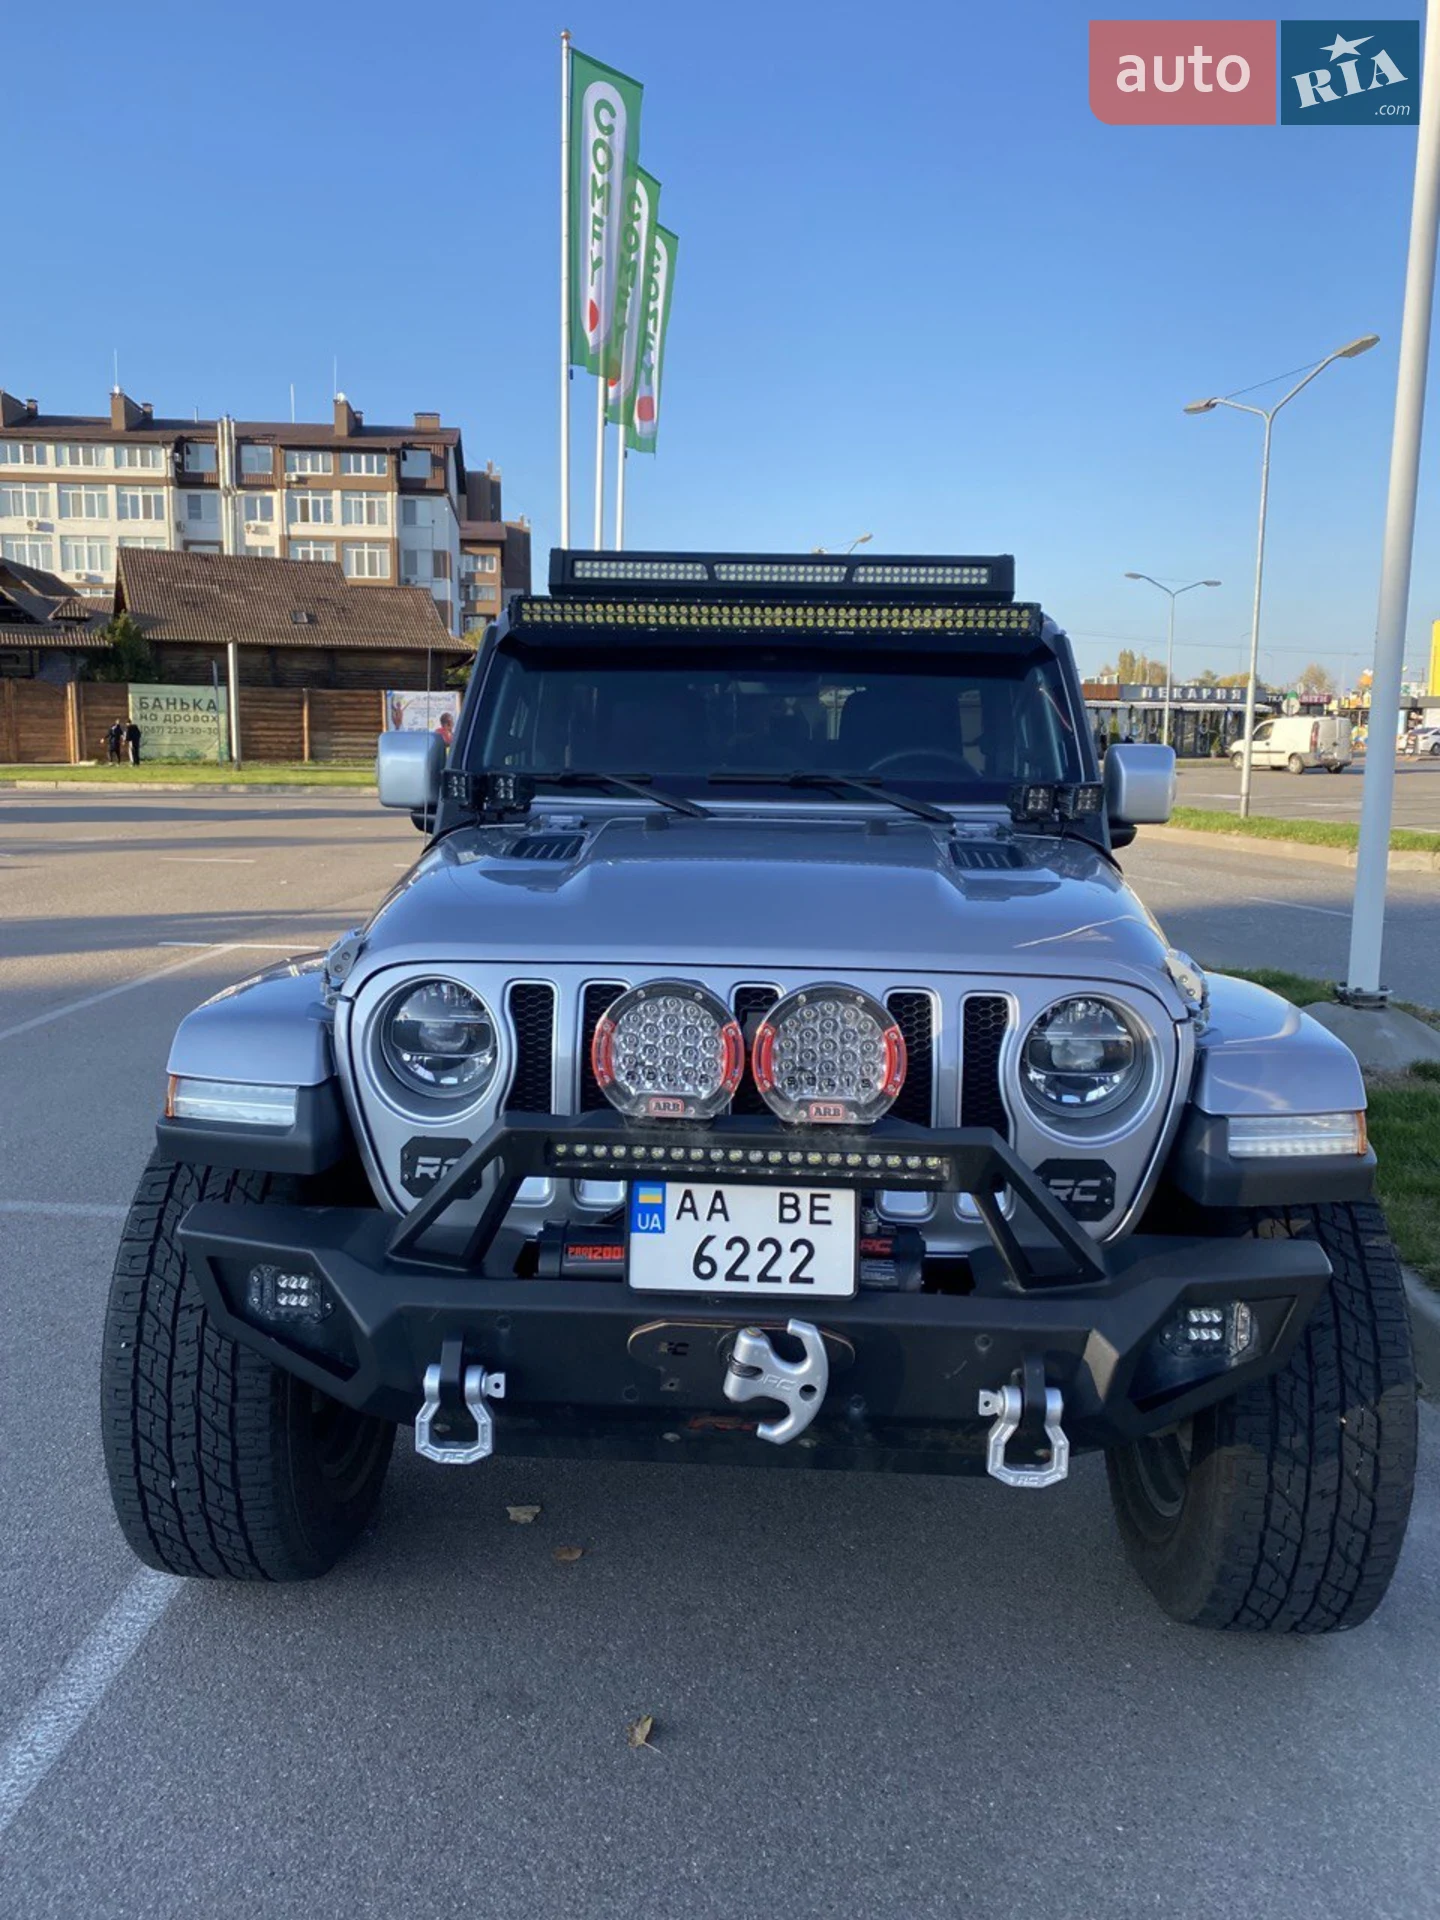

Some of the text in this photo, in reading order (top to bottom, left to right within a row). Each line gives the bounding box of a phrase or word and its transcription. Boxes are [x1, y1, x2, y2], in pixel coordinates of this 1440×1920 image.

[590, 98, 617, 287] COMFY
[1142, 687, 1242, 700] ПЕКАРНЯ
[139, 696, 218, 712] БАНЬКА
[140, 713, 219, 725] на дровах
[654, 1102, 681, 1112] ARB
[814, 1106, 842, 1117] ARB
[676, 1188, 833, 1226] AA BE
[637, 1213, 662, 1231] UA
[691, 1234, 816, 1285] 6222
